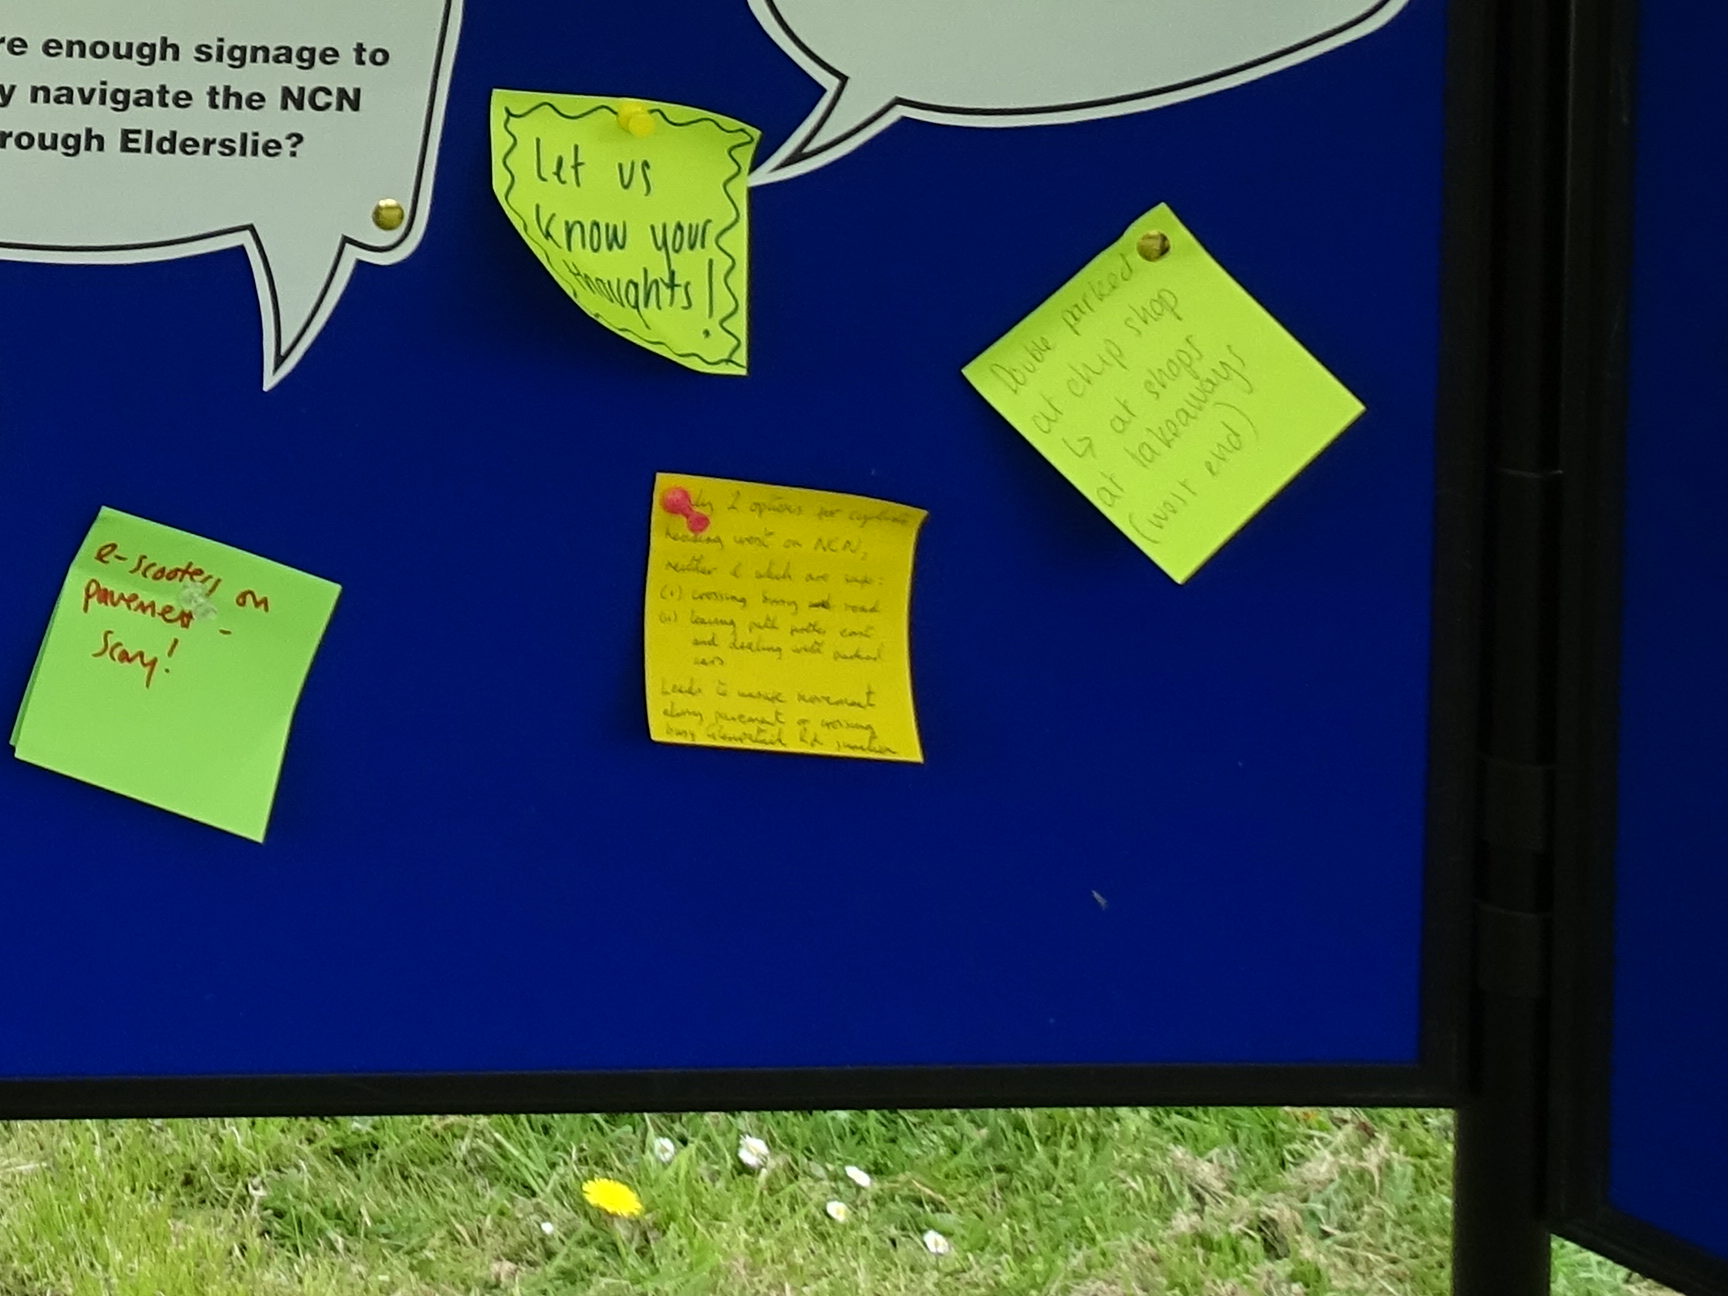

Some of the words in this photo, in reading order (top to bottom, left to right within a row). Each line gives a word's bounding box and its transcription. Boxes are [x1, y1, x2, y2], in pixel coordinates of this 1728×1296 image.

[618, 159, 652, 196] us
[650, 219, 713, 274] your
[235, 589, 269, 612] on
